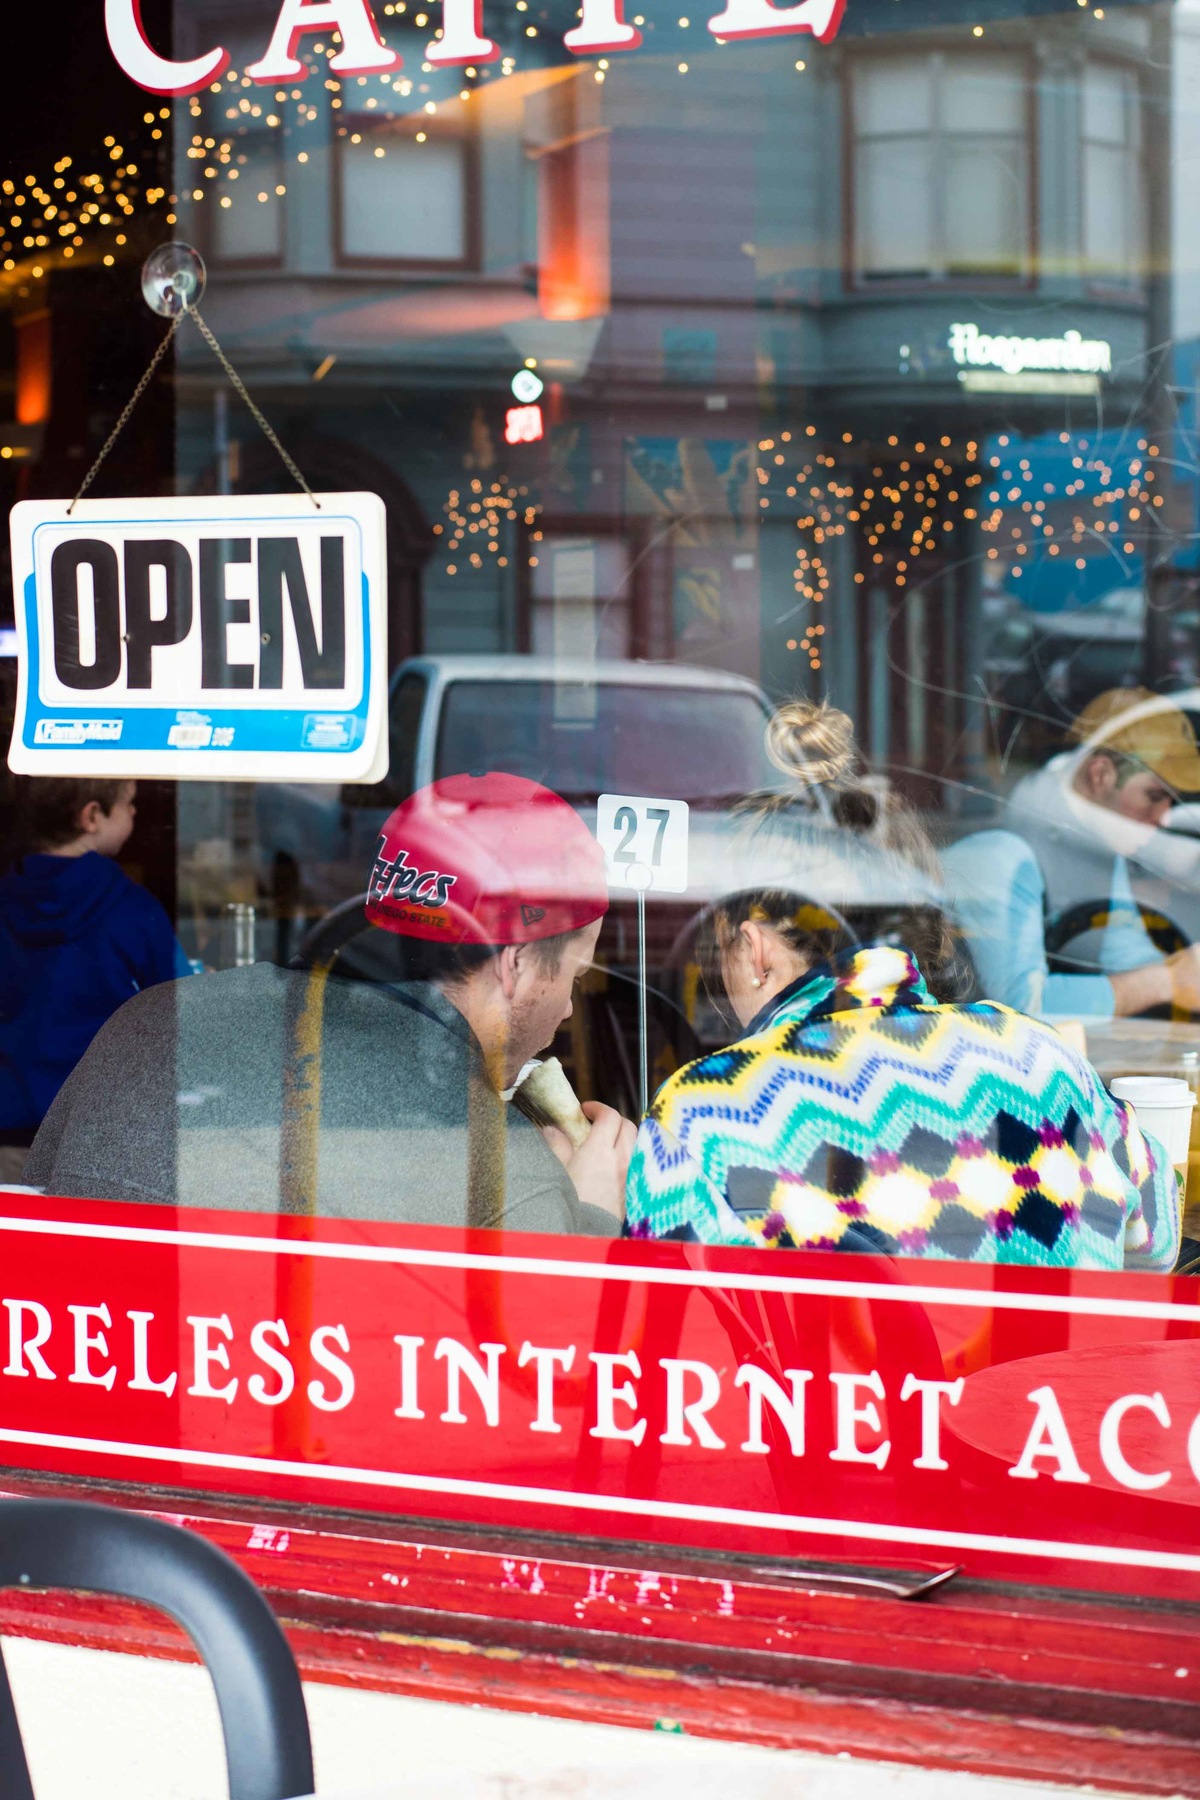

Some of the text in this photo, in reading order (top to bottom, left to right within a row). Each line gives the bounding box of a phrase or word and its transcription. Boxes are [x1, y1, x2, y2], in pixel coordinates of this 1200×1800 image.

[51, 536, 346, 690] OPEN
[613, 806, 670, 867] 27
[409, 912, 446, 928] STATE
[2, 1298, 1200, 1492] RELESS INTERNET AC
